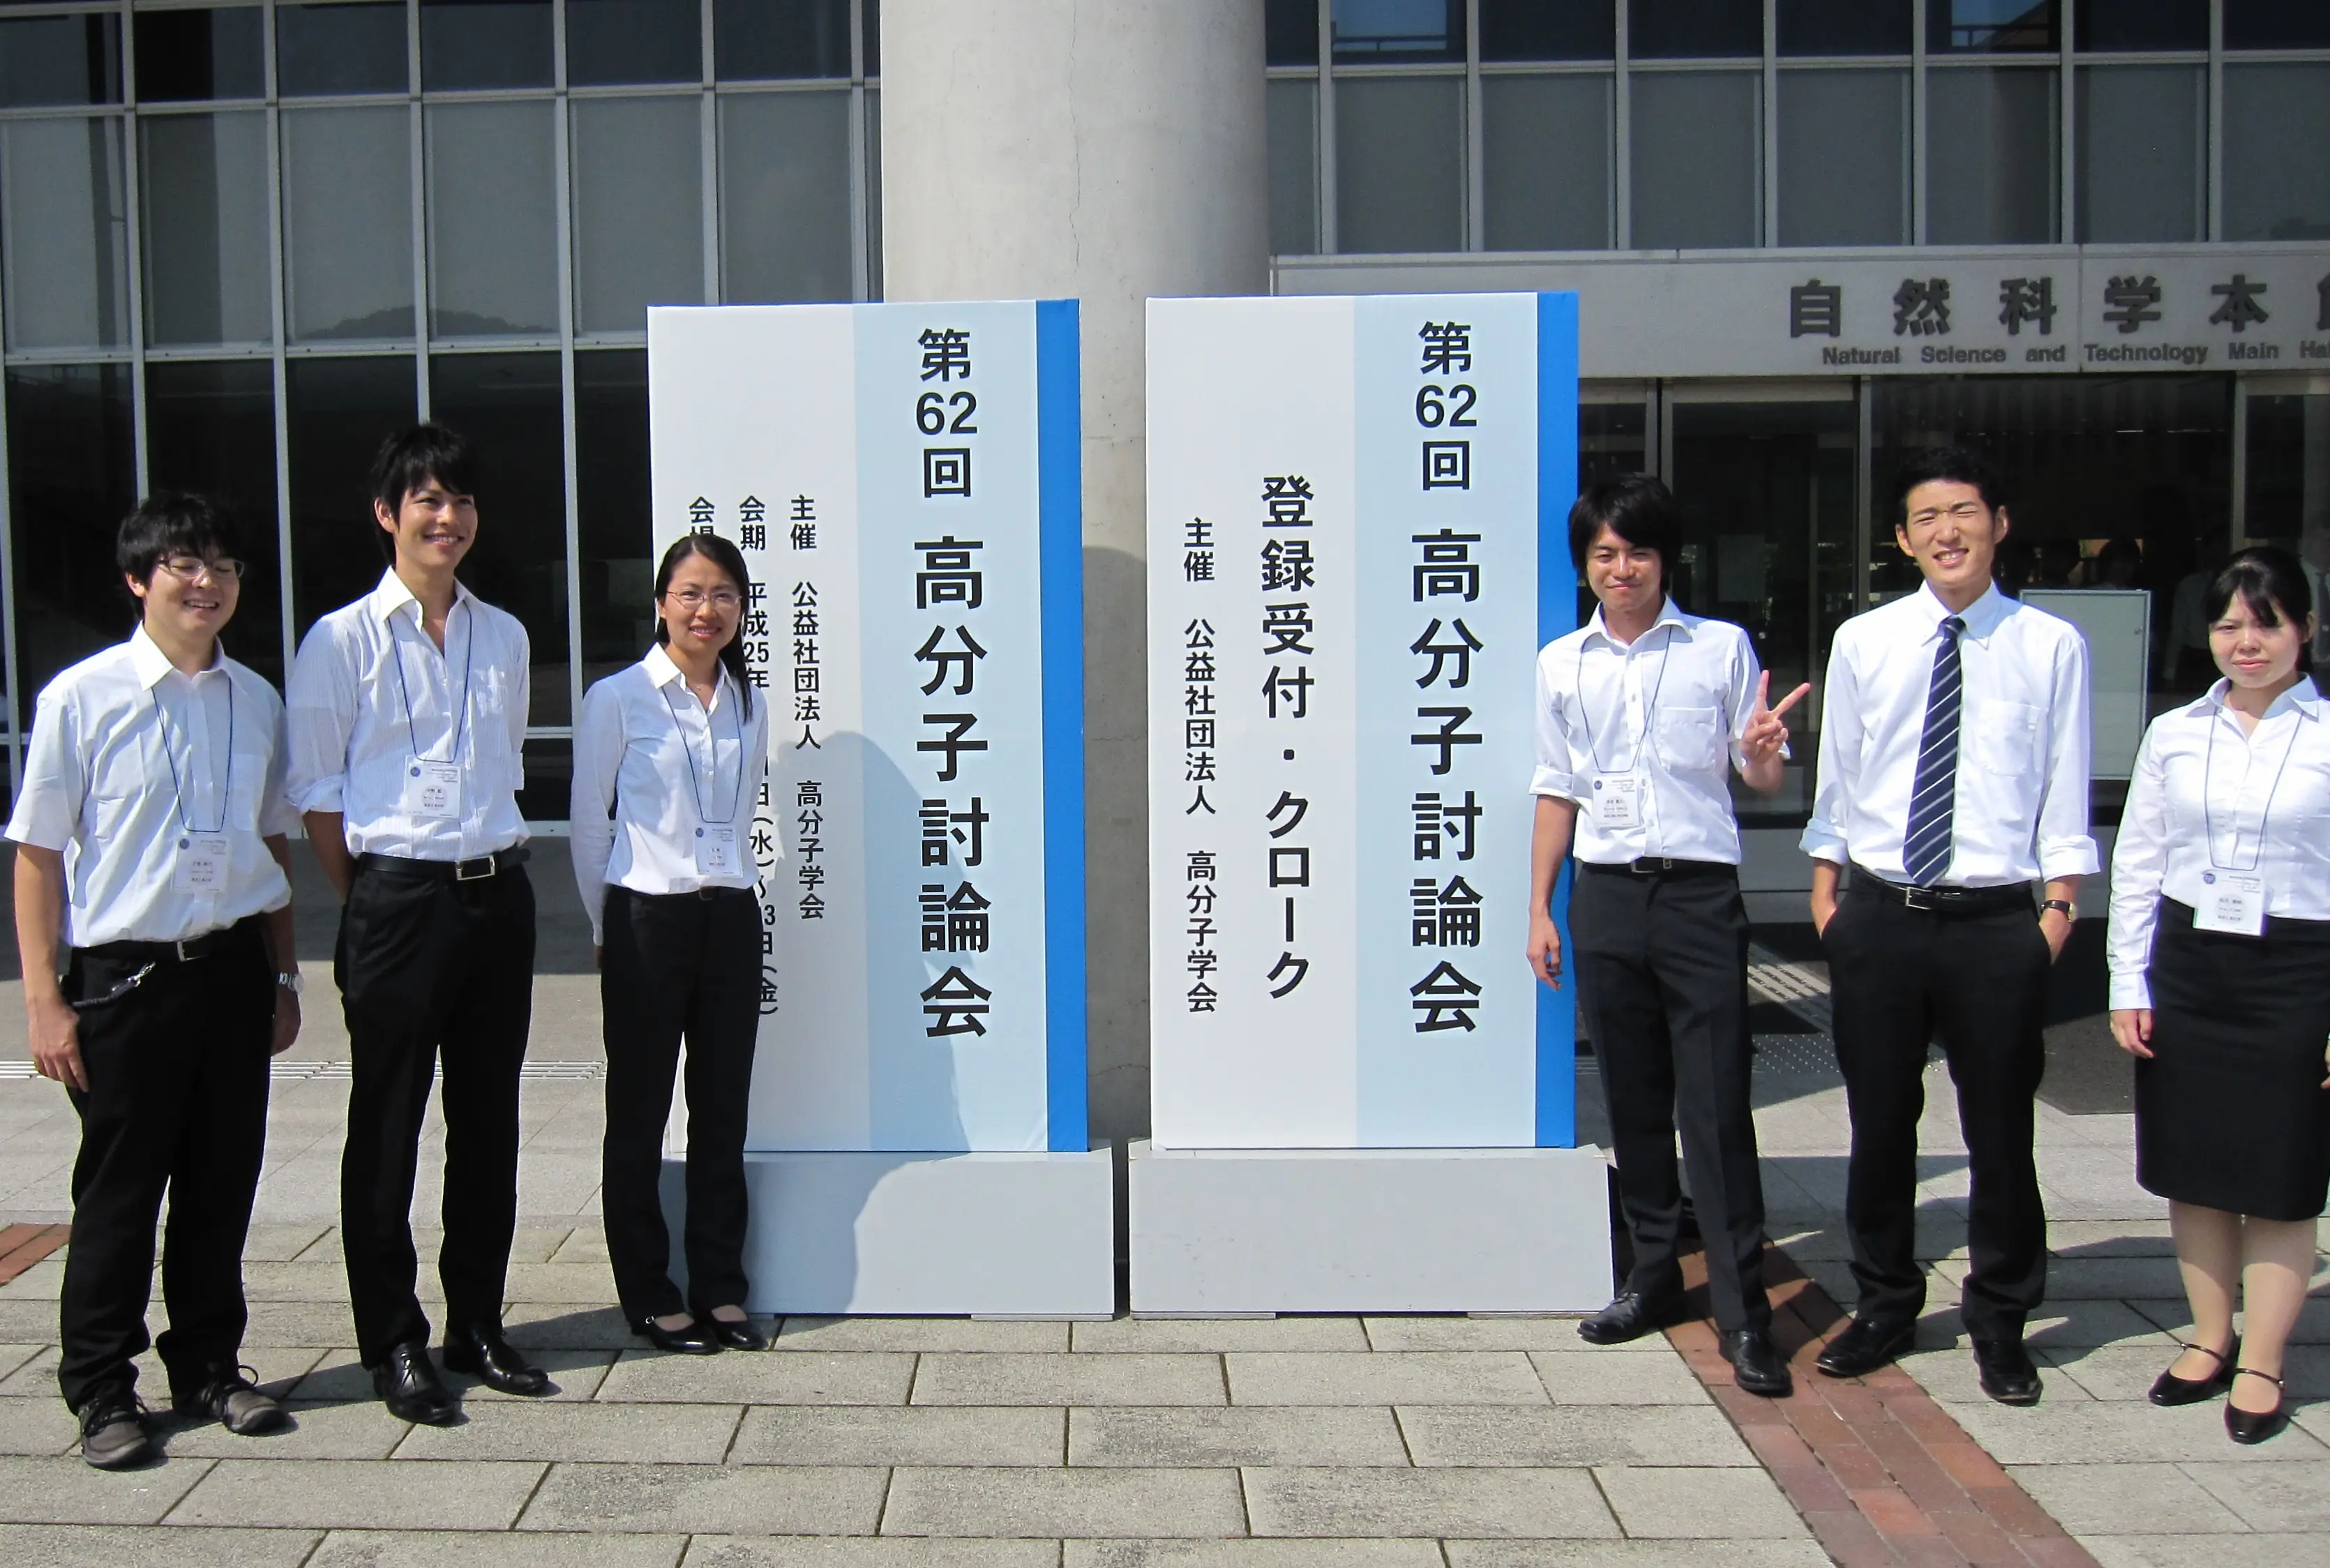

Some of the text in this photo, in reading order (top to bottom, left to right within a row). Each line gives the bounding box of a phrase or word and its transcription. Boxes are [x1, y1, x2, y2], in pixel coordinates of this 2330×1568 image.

[739, 495, 766, 551] 会期
[1790, 274, 2330, 337] 自然科学本
[1822, 346, 1900, 365] Natural
[1921, 345, 2006, 363] Science
[2026, 345, 2066, 362] and
[2084, 342, 2209, 365] Technology
[2228, 342, 2279, 360] Main
[790, 495, 825, 920] 主催 公益社団法人 高分子学会
[914, 328, 993, 1038] 第62回 高分子討論会
[1184, 517, 1218, 1013] 主催 公益社団法人 高分子学会
[1260, 474, 1316, 1000] 登録受付・クローク
[1409, 321, 1485, 1034] 第62回 高分子討論会
